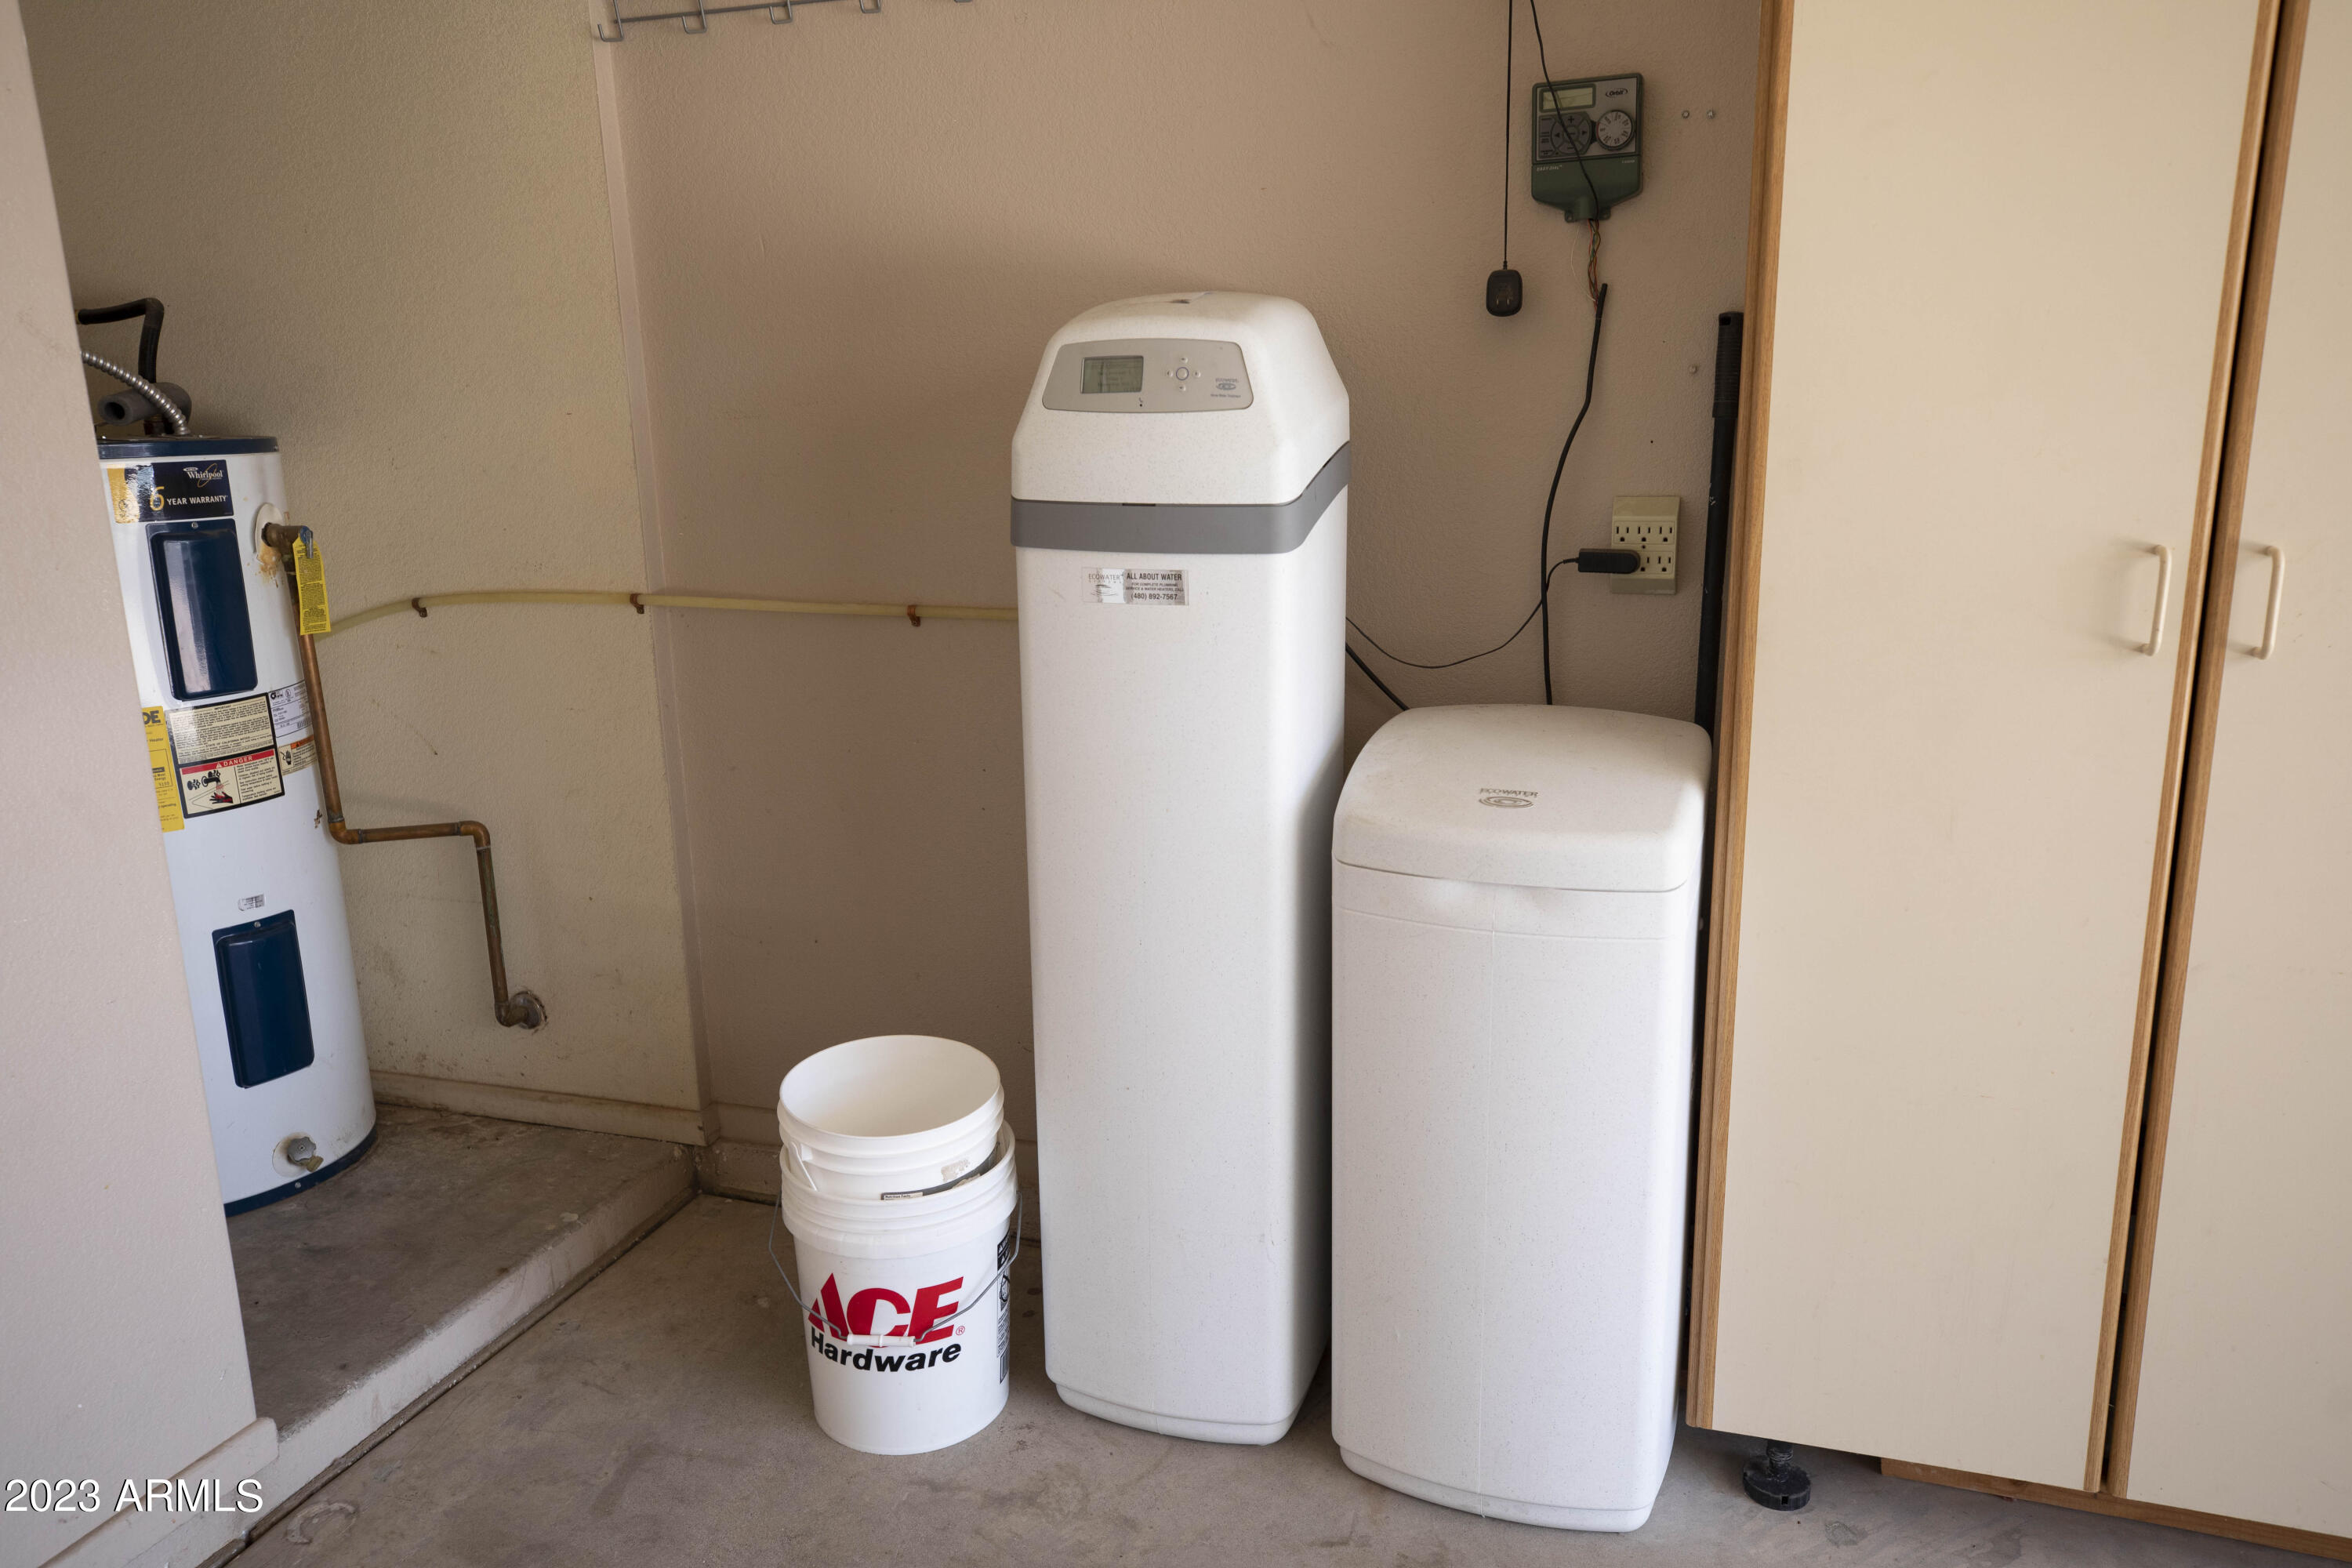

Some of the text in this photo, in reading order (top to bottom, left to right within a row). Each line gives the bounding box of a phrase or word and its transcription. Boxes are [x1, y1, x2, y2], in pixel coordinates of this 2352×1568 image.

[187, 470, 223, 480] Whirlpool
[149, 485, 165, 511] 6
[189, 495, 227, 504] WARRANTY
[223, 756, 253, 767] DANGER
[1479, 788, 1538, 797] ECOWATER
[808, 1272, 964, 1348] ACE
[811, 1325, 962, 1372] Hardware
